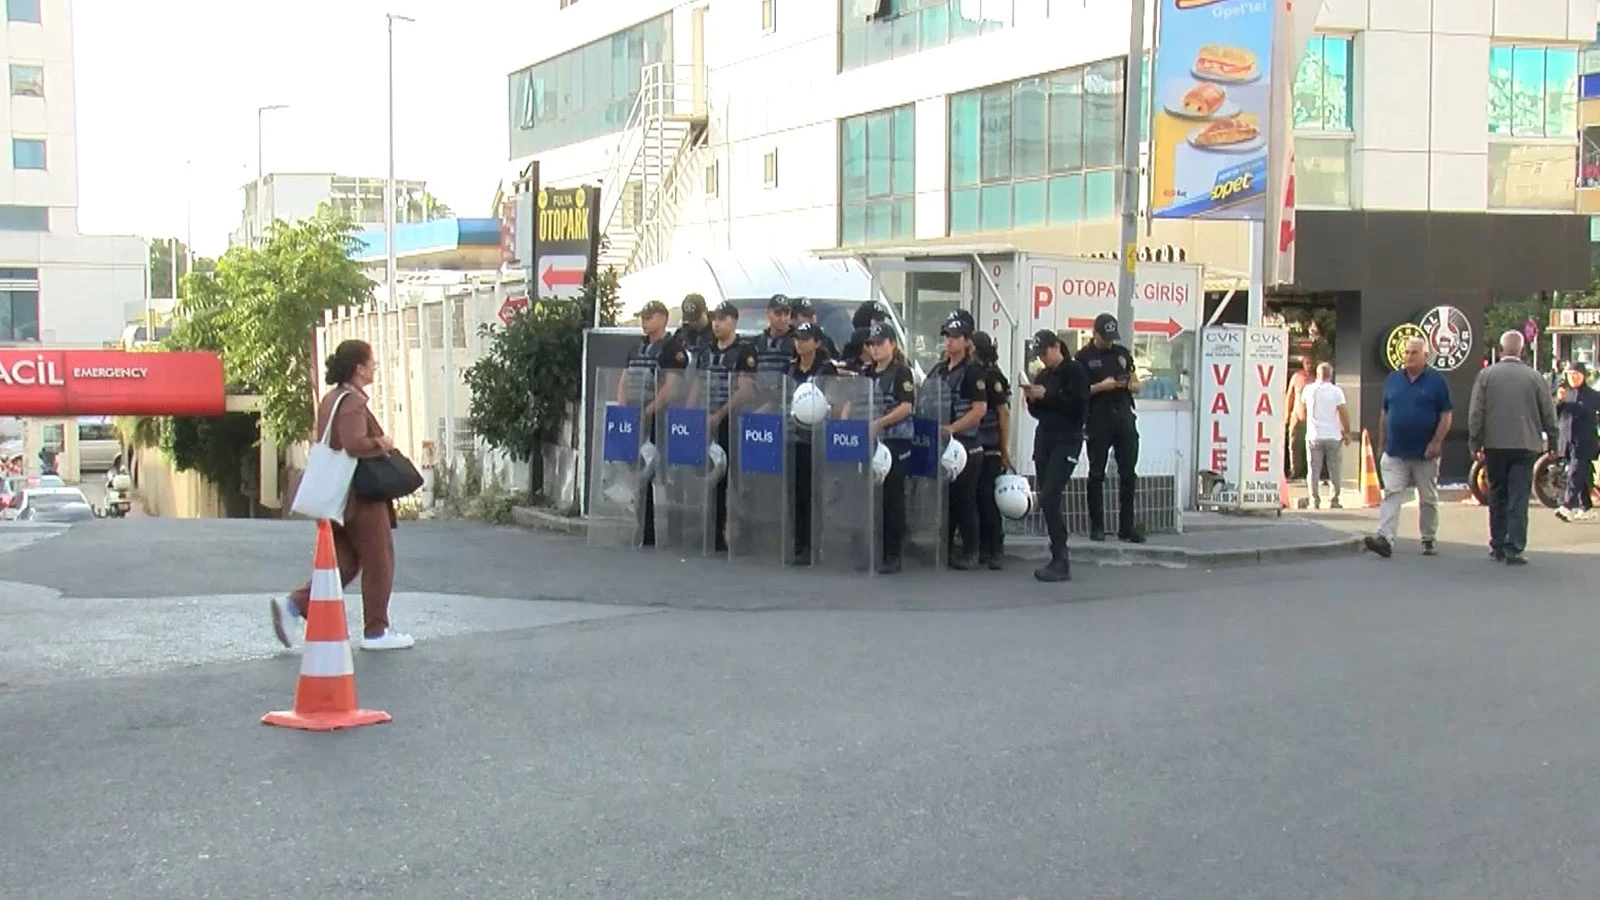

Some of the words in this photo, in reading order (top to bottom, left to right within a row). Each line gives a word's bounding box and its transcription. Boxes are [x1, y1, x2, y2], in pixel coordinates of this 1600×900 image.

[539, 208, 589, 241] OTOPARK
[1034, 285, 1053, 320] P
[1062, 279, 1139, 300] OTOPA
[1144, 282, 1189, 306] GİRİŞİ
[1206, 333, 1239, 342] CVK
[1250, 333, 1281, 343] CVK
[0, 353, 64, 386] ACİL
[74, 367, 148, 378] EMERGENCY
[1254, 363, 1275, 472] VALE
[745, 429, 773, 443] POLİS
[833, 432, 859, 447] POLİS
